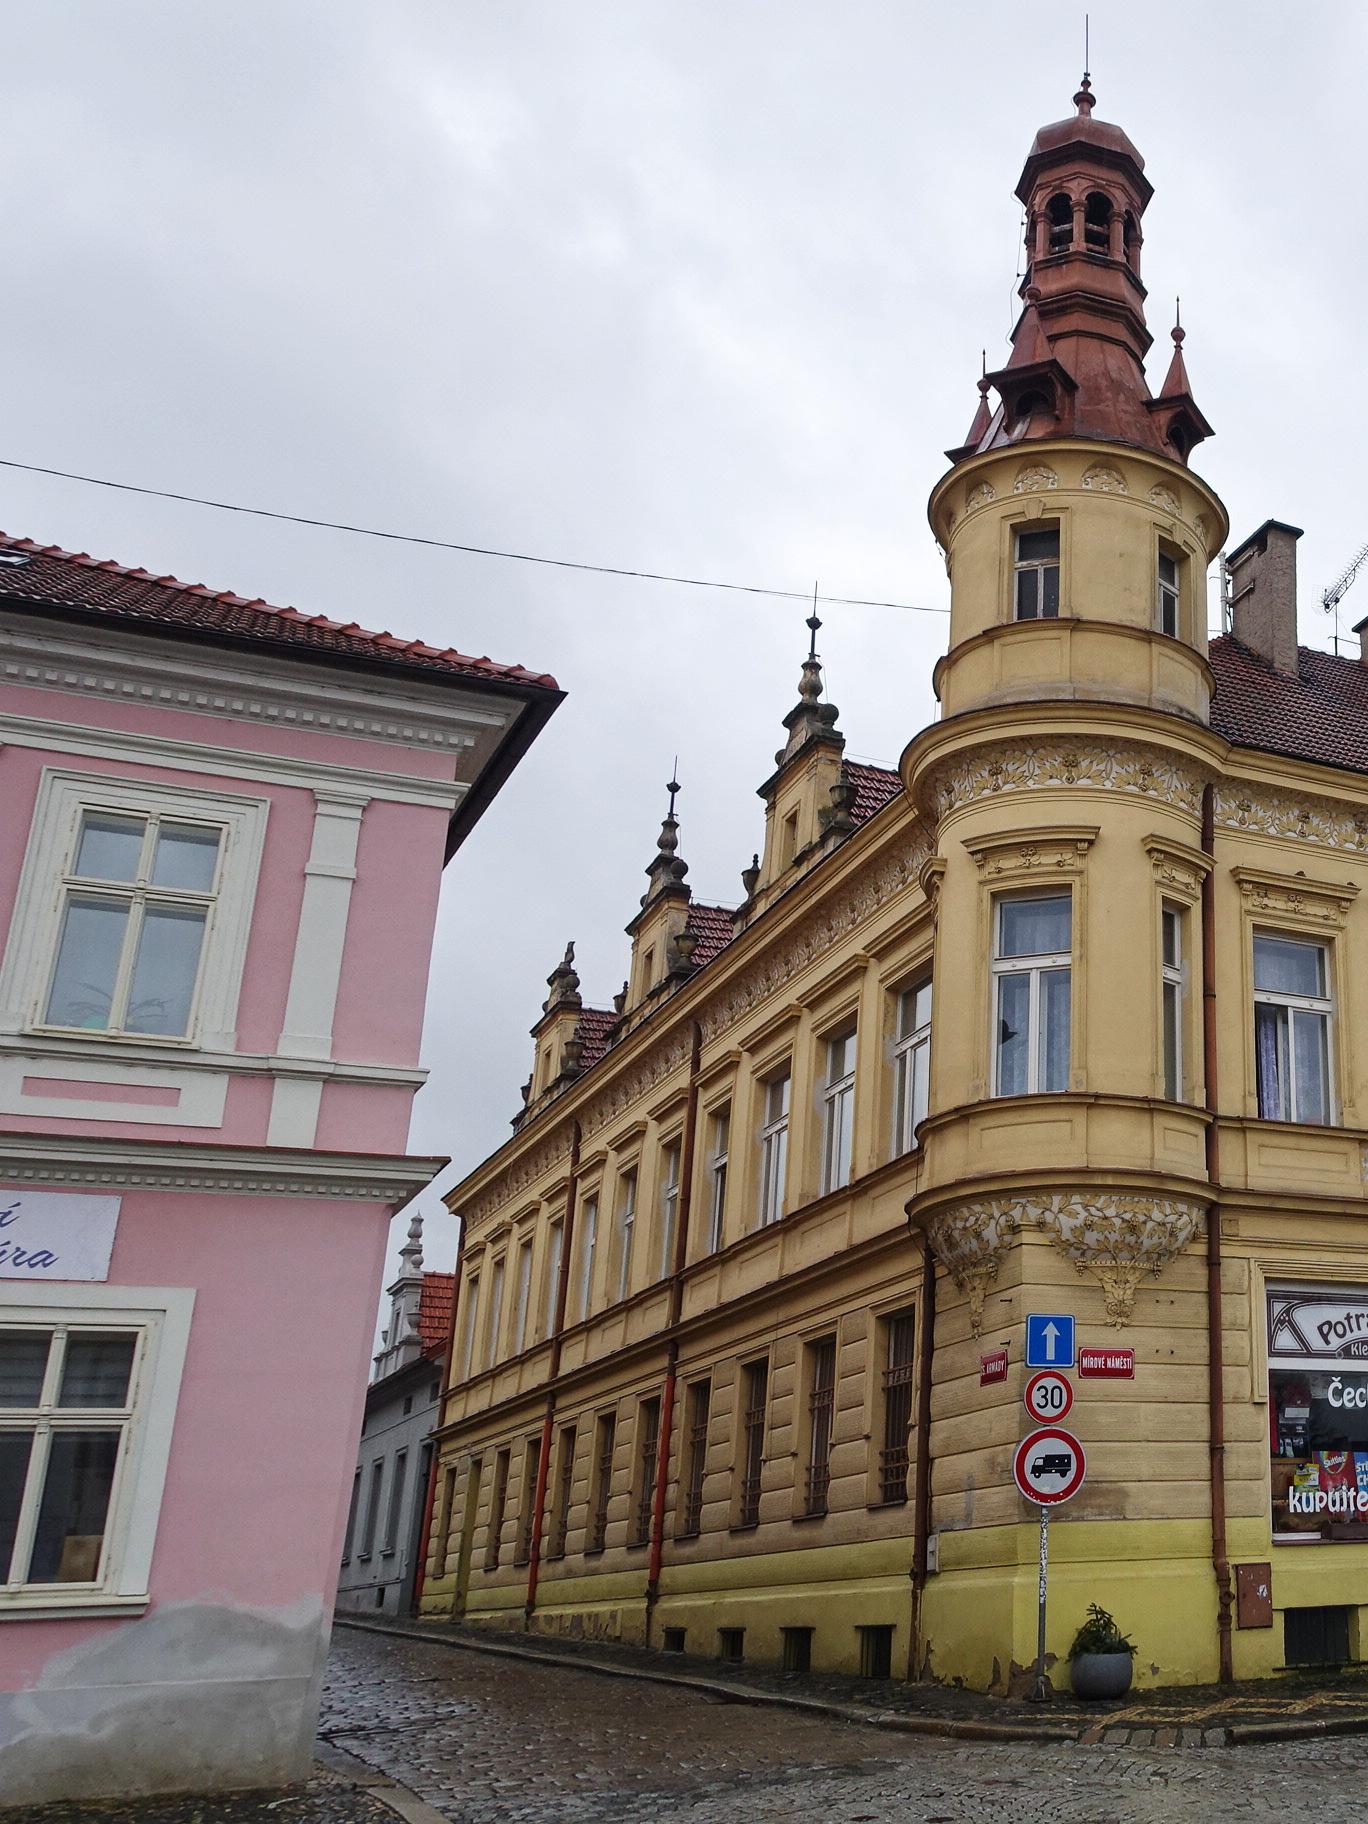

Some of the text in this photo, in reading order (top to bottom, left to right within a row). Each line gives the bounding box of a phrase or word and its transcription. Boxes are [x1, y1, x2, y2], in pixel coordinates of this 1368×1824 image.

[1082, 1355, 1133, 1370] MÍROVÉ NÁMĚSTÍ
[1036, 1385, 1063, 1410] 30
[1289, 1486, 1368, 1513] kupujte
